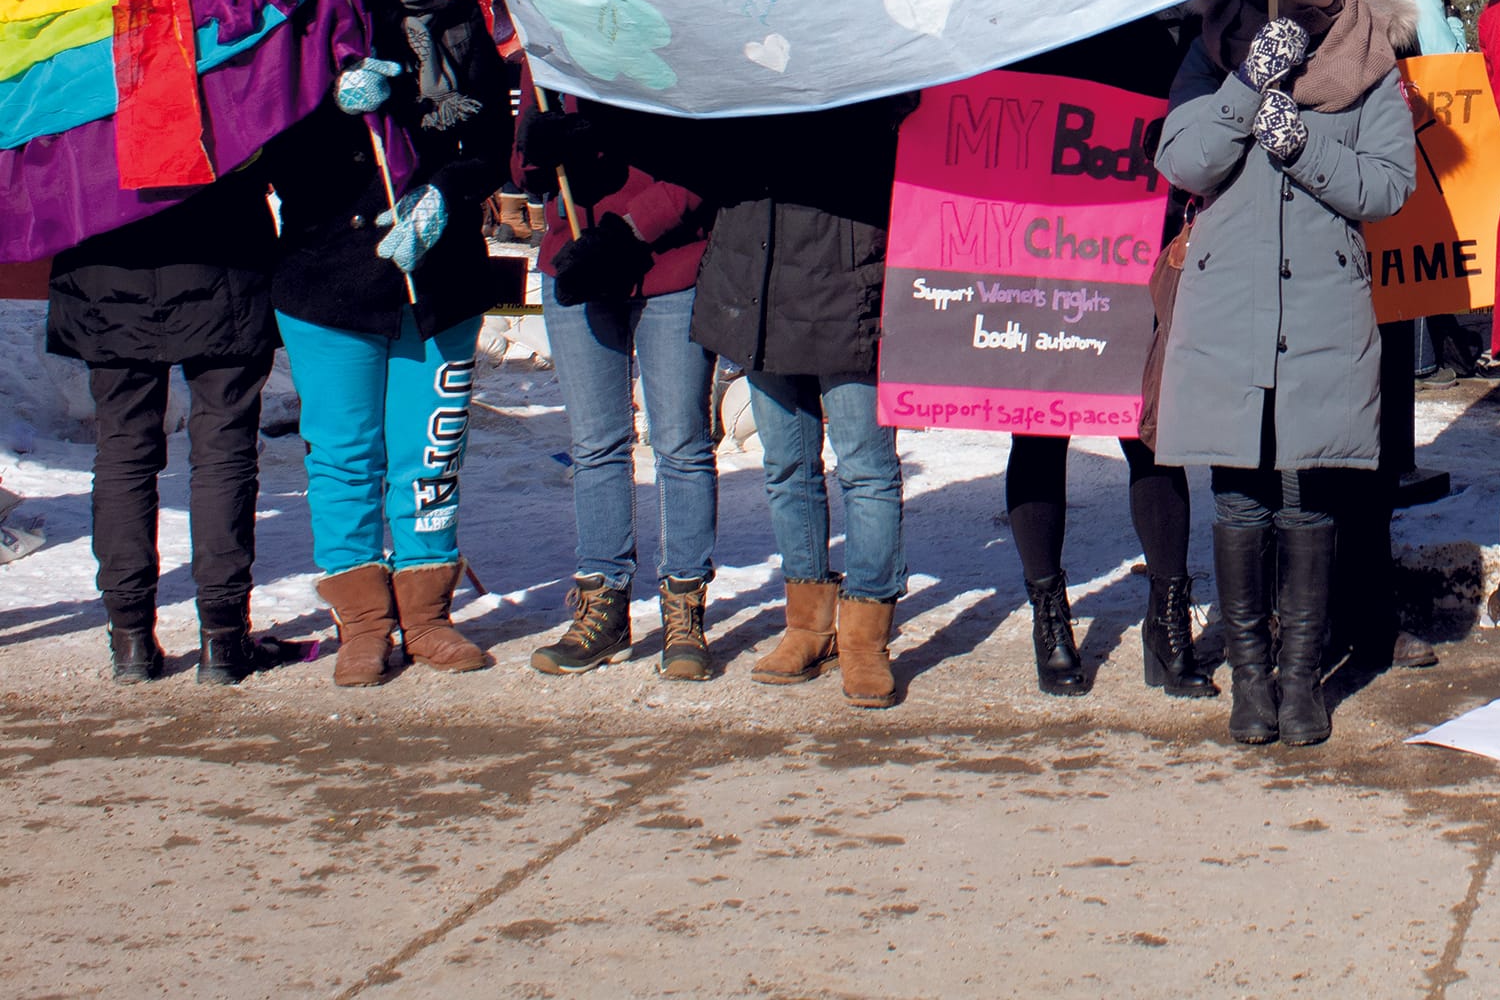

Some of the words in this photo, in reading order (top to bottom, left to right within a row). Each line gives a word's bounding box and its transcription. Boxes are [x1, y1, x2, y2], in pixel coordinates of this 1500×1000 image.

[944, 93, 1044, 169] MY
[940, 200, 1027, 268] MY
[1366, 239, 1483, 287] AME
[912, 277, 975, 311] Support
[1051, 287, 1112, 324] rights
[1035, 331, 1108, 357] autonomy
[893, 390, 993, 424] Support
